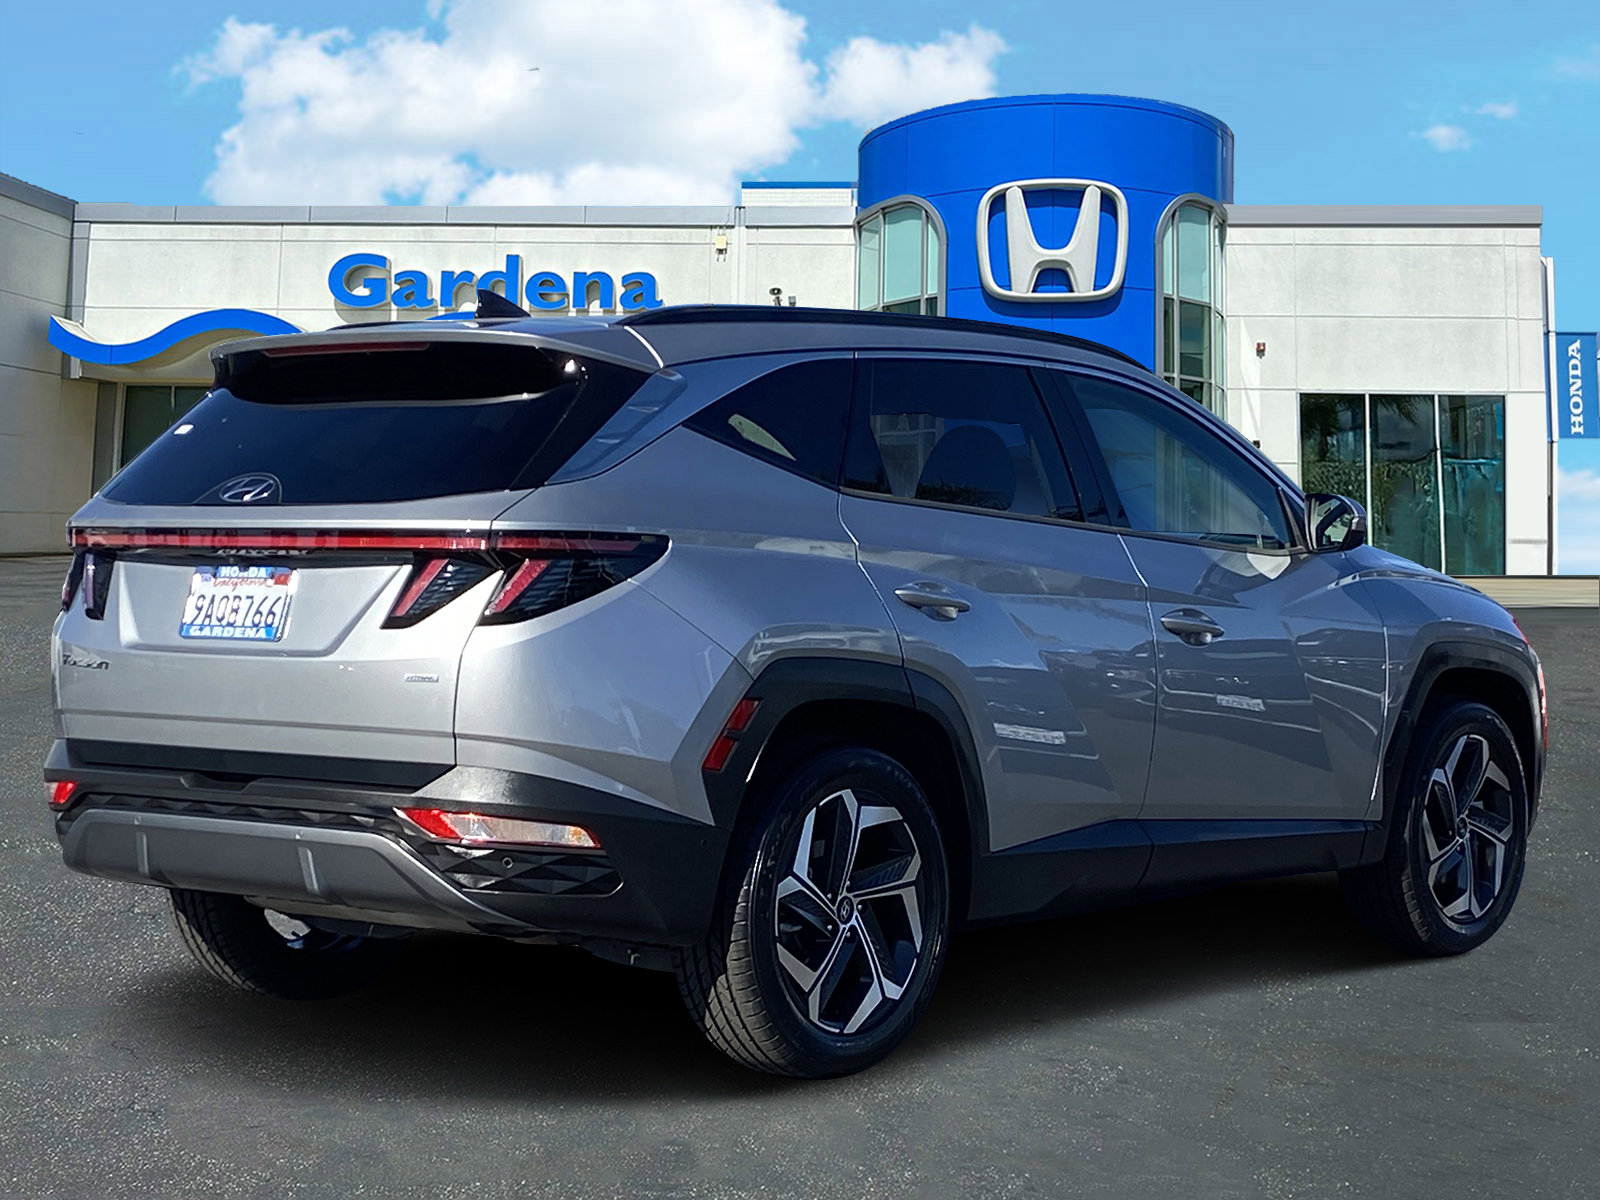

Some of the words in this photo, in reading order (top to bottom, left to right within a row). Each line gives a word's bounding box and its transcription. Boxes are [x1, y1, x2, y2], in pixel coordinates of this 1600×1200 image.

[328, 253, 663, 309] Gardena
[1568, 339, 1585, 435] HONDA
[189, 626, 267, 638] GARDENA
